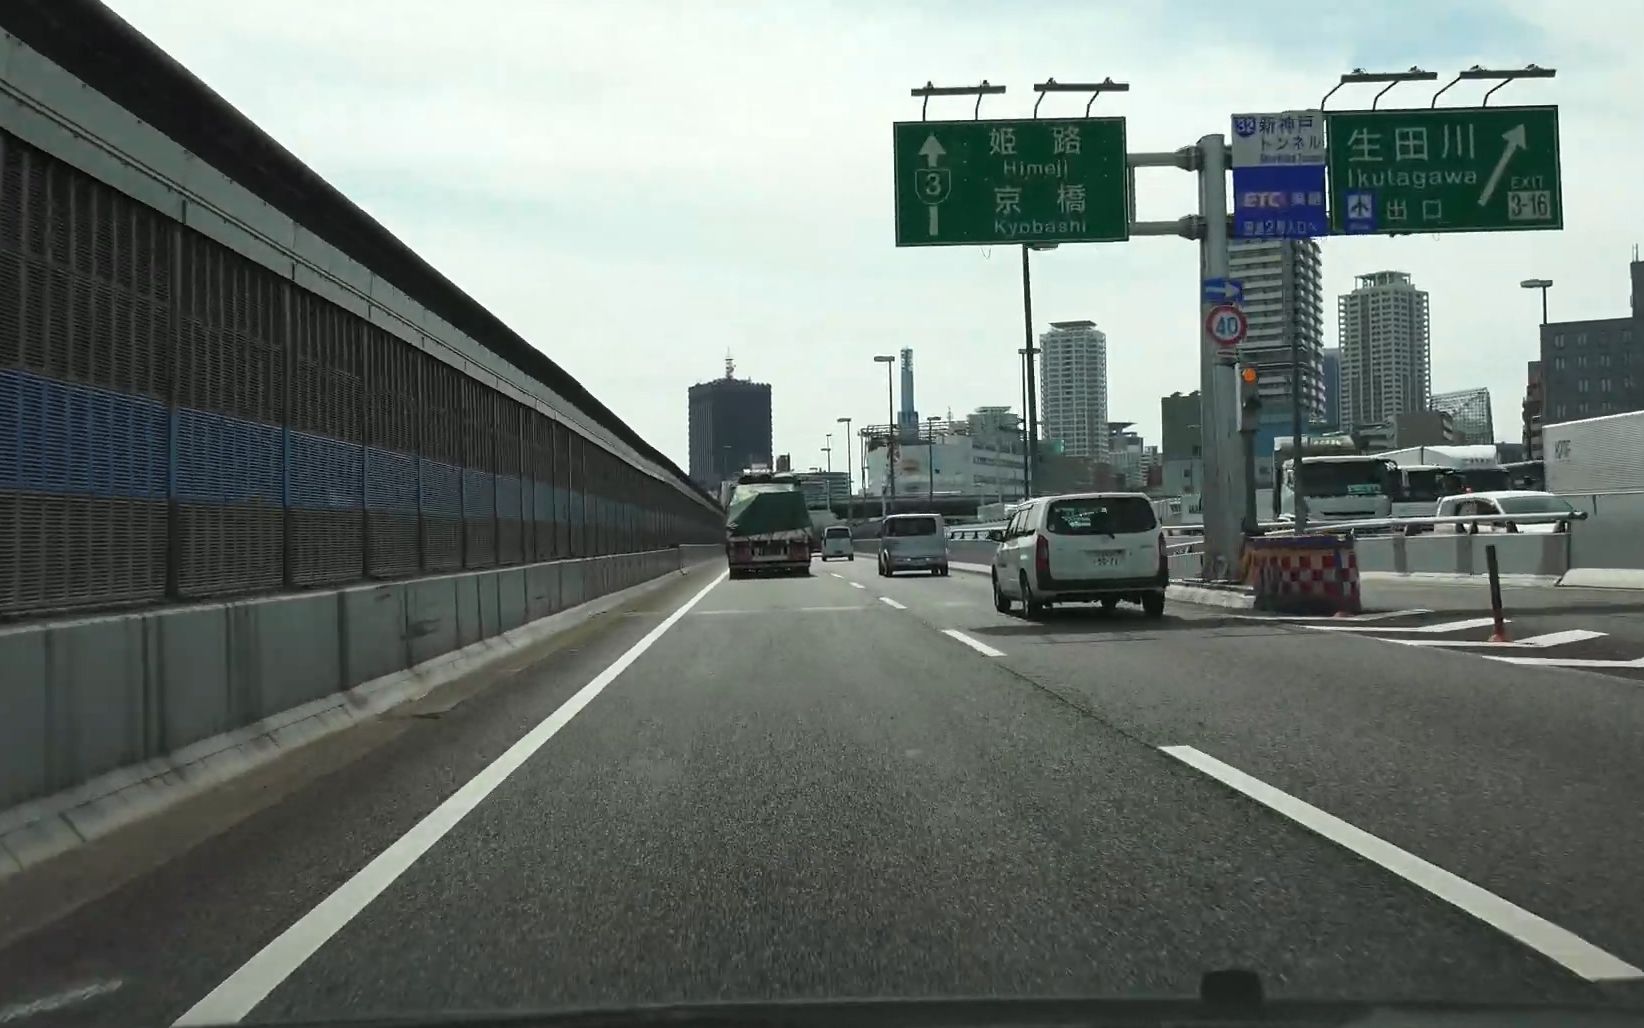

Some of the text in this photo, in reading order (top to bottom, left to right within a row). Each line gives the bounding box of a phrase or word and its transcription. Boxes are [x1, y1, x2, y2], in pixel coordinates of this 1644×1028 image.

[1260, 116, 1314, 134] 新神戸
[989, 126, 1082, 156] 姫路
[1261, 135, 1321, 151] トンネル
[1347, 123, 1476, 162] 生田川
[1003, 159, 1068, 179] Himeji
[1348, 168, 1477, 189] Ikutagawa
[925, 173, 942, 196] 3
[1511, 175, 1544, 189] EXIT
[994, 183, 1087, 215] 京橋
[1244, 191, 1281, 208] ETC
[1511, 193, 1548, 217] 3-16
[1386, 199, 1442, 221] 出口
[994, 218, 1087, 238] Kyobashi
[1215, 315, 1238, 336] 40
